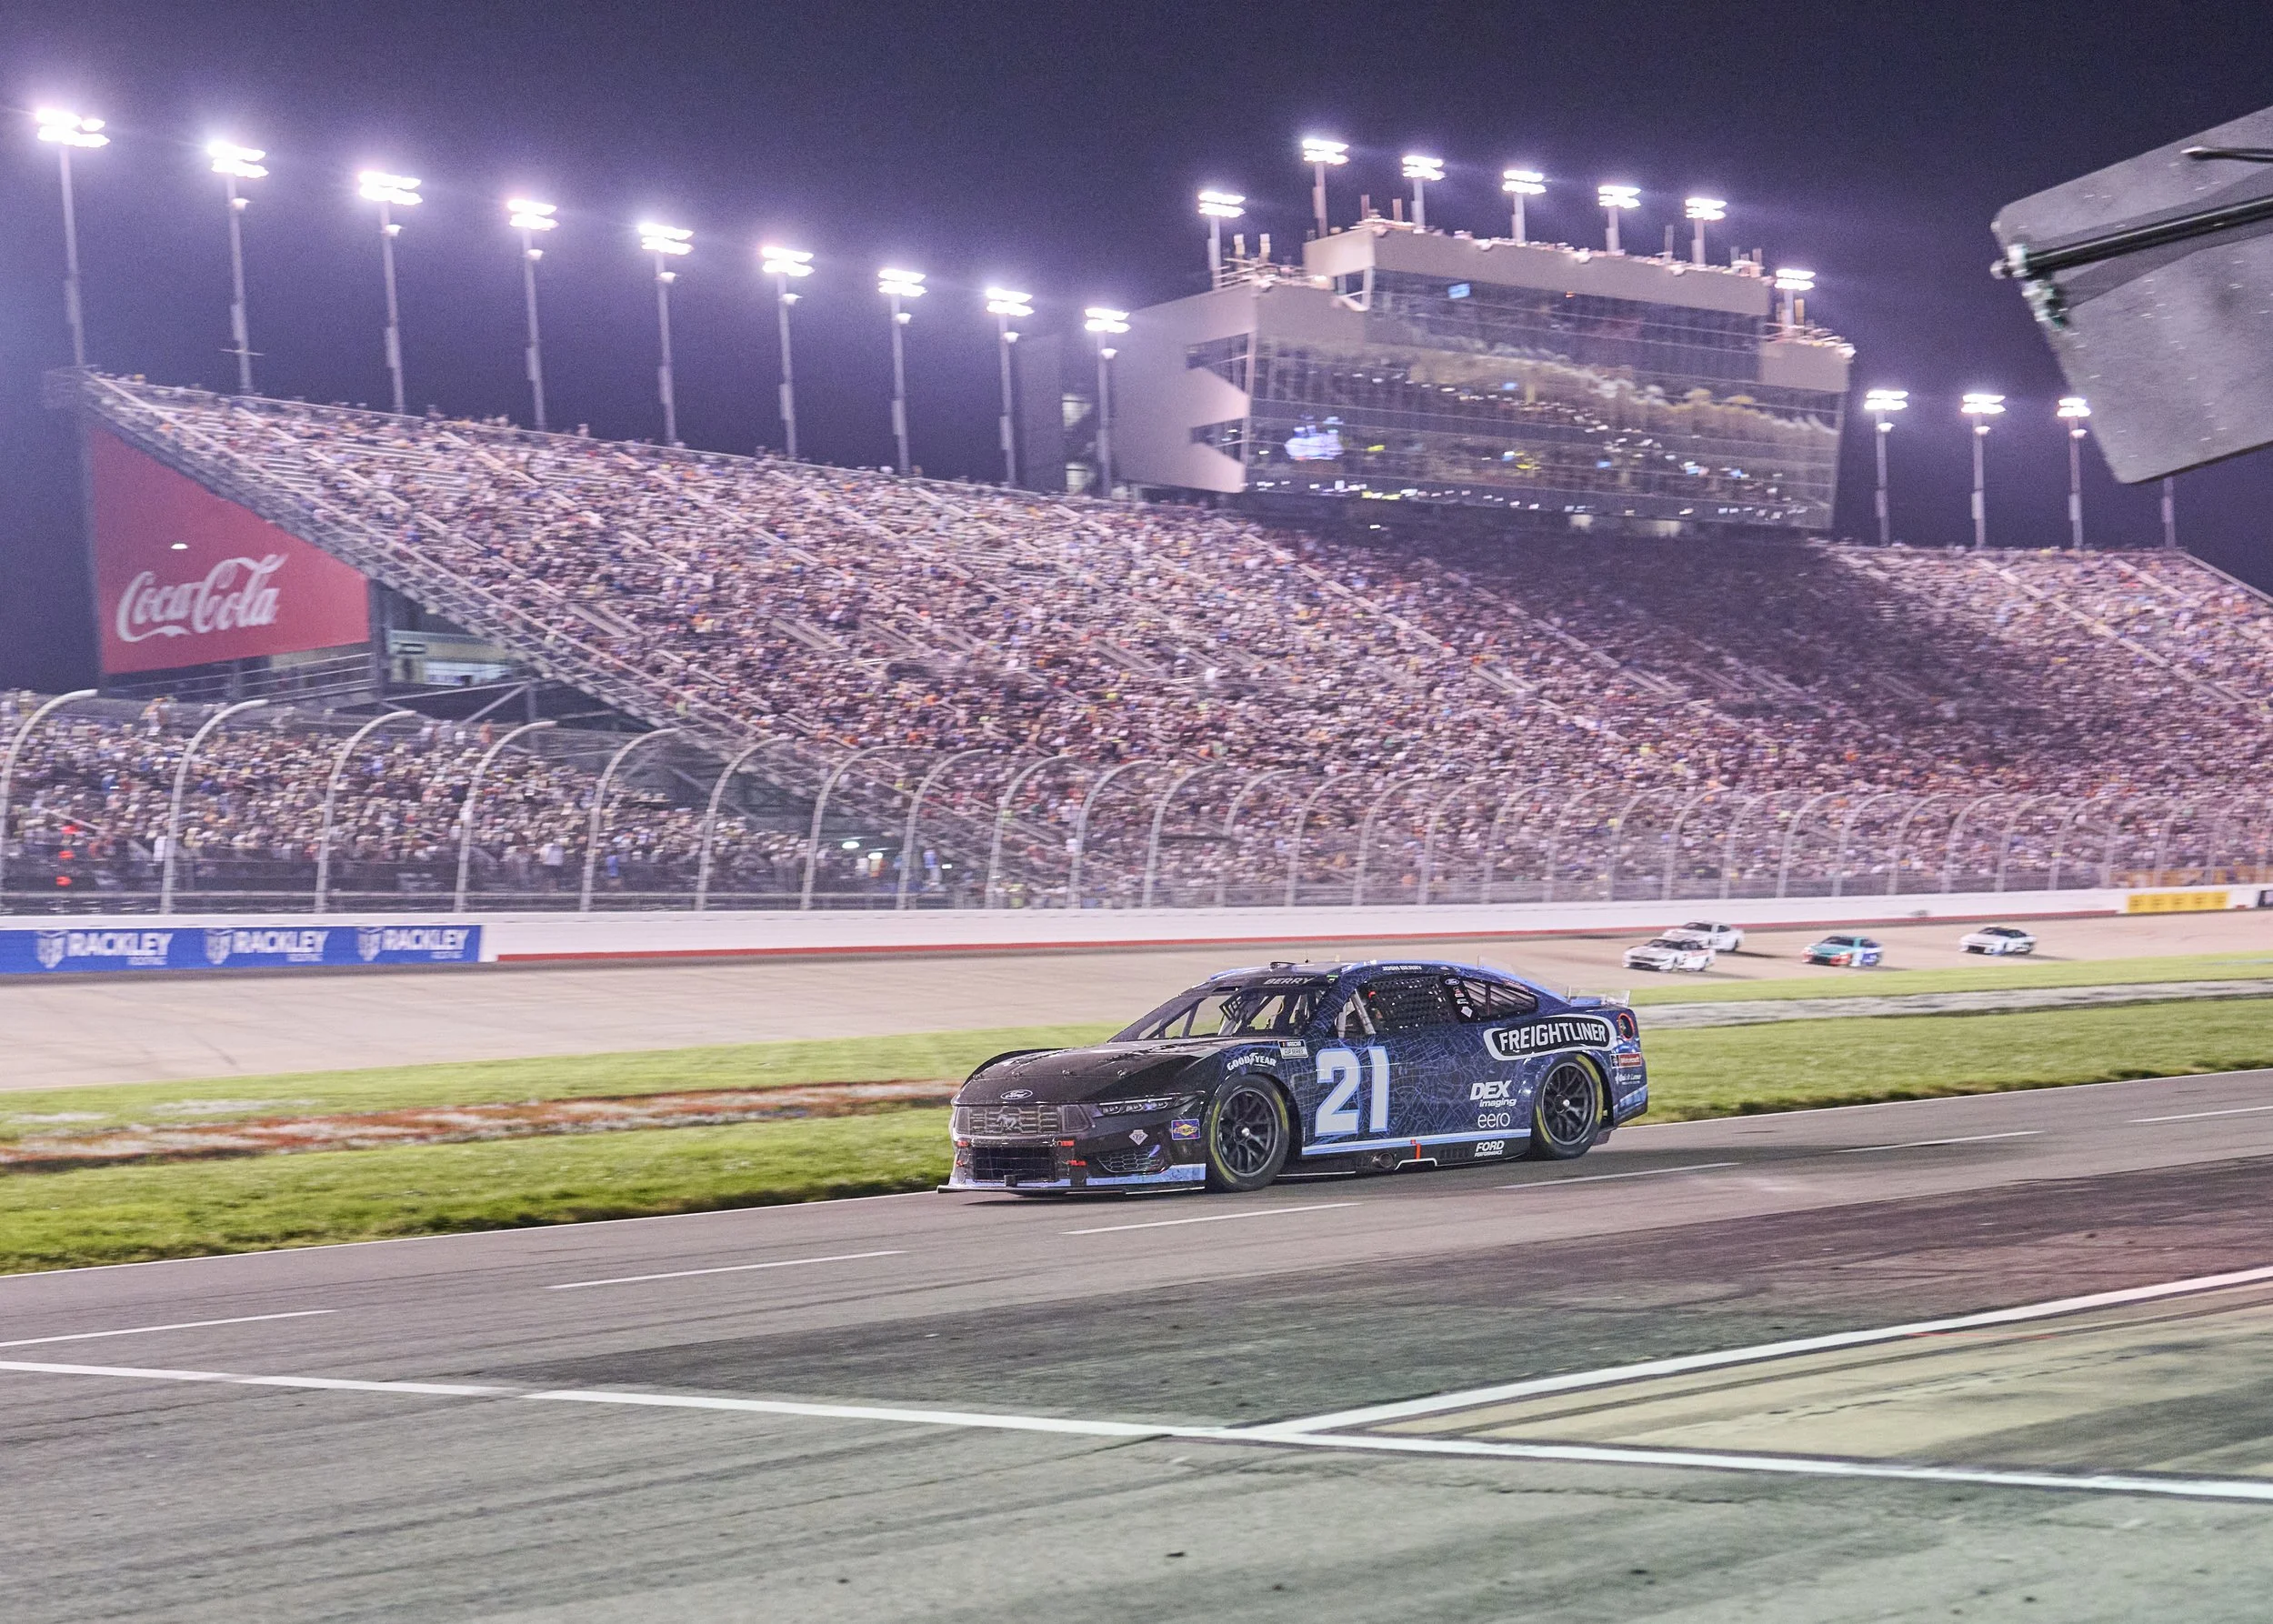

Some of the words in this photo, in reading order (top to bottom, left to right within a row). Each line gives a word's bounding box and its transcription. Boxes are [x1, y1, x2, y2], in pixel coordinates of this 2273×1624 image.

[66, 932, 174, 957] RACKLEY
[232, 930, 330, 954] RACKLEY
[382, 928, 470, 951] RACKLEY
[1263, 977, 1317, 985] BERRY
[1498, 1022, 1607, 1051] FREIGHTLINER
[1227, 1052, 1277, 1071] GOODYEAR
[1315, 1046, 1390, 1137] 21
[1469, 1080, 1512, 1100] DEX
[1479, 1098, 1517, 1108] imaging
[1477, 1112, 1510, 1128] eero
[1476, 1140, 1505, 1152] FORD
